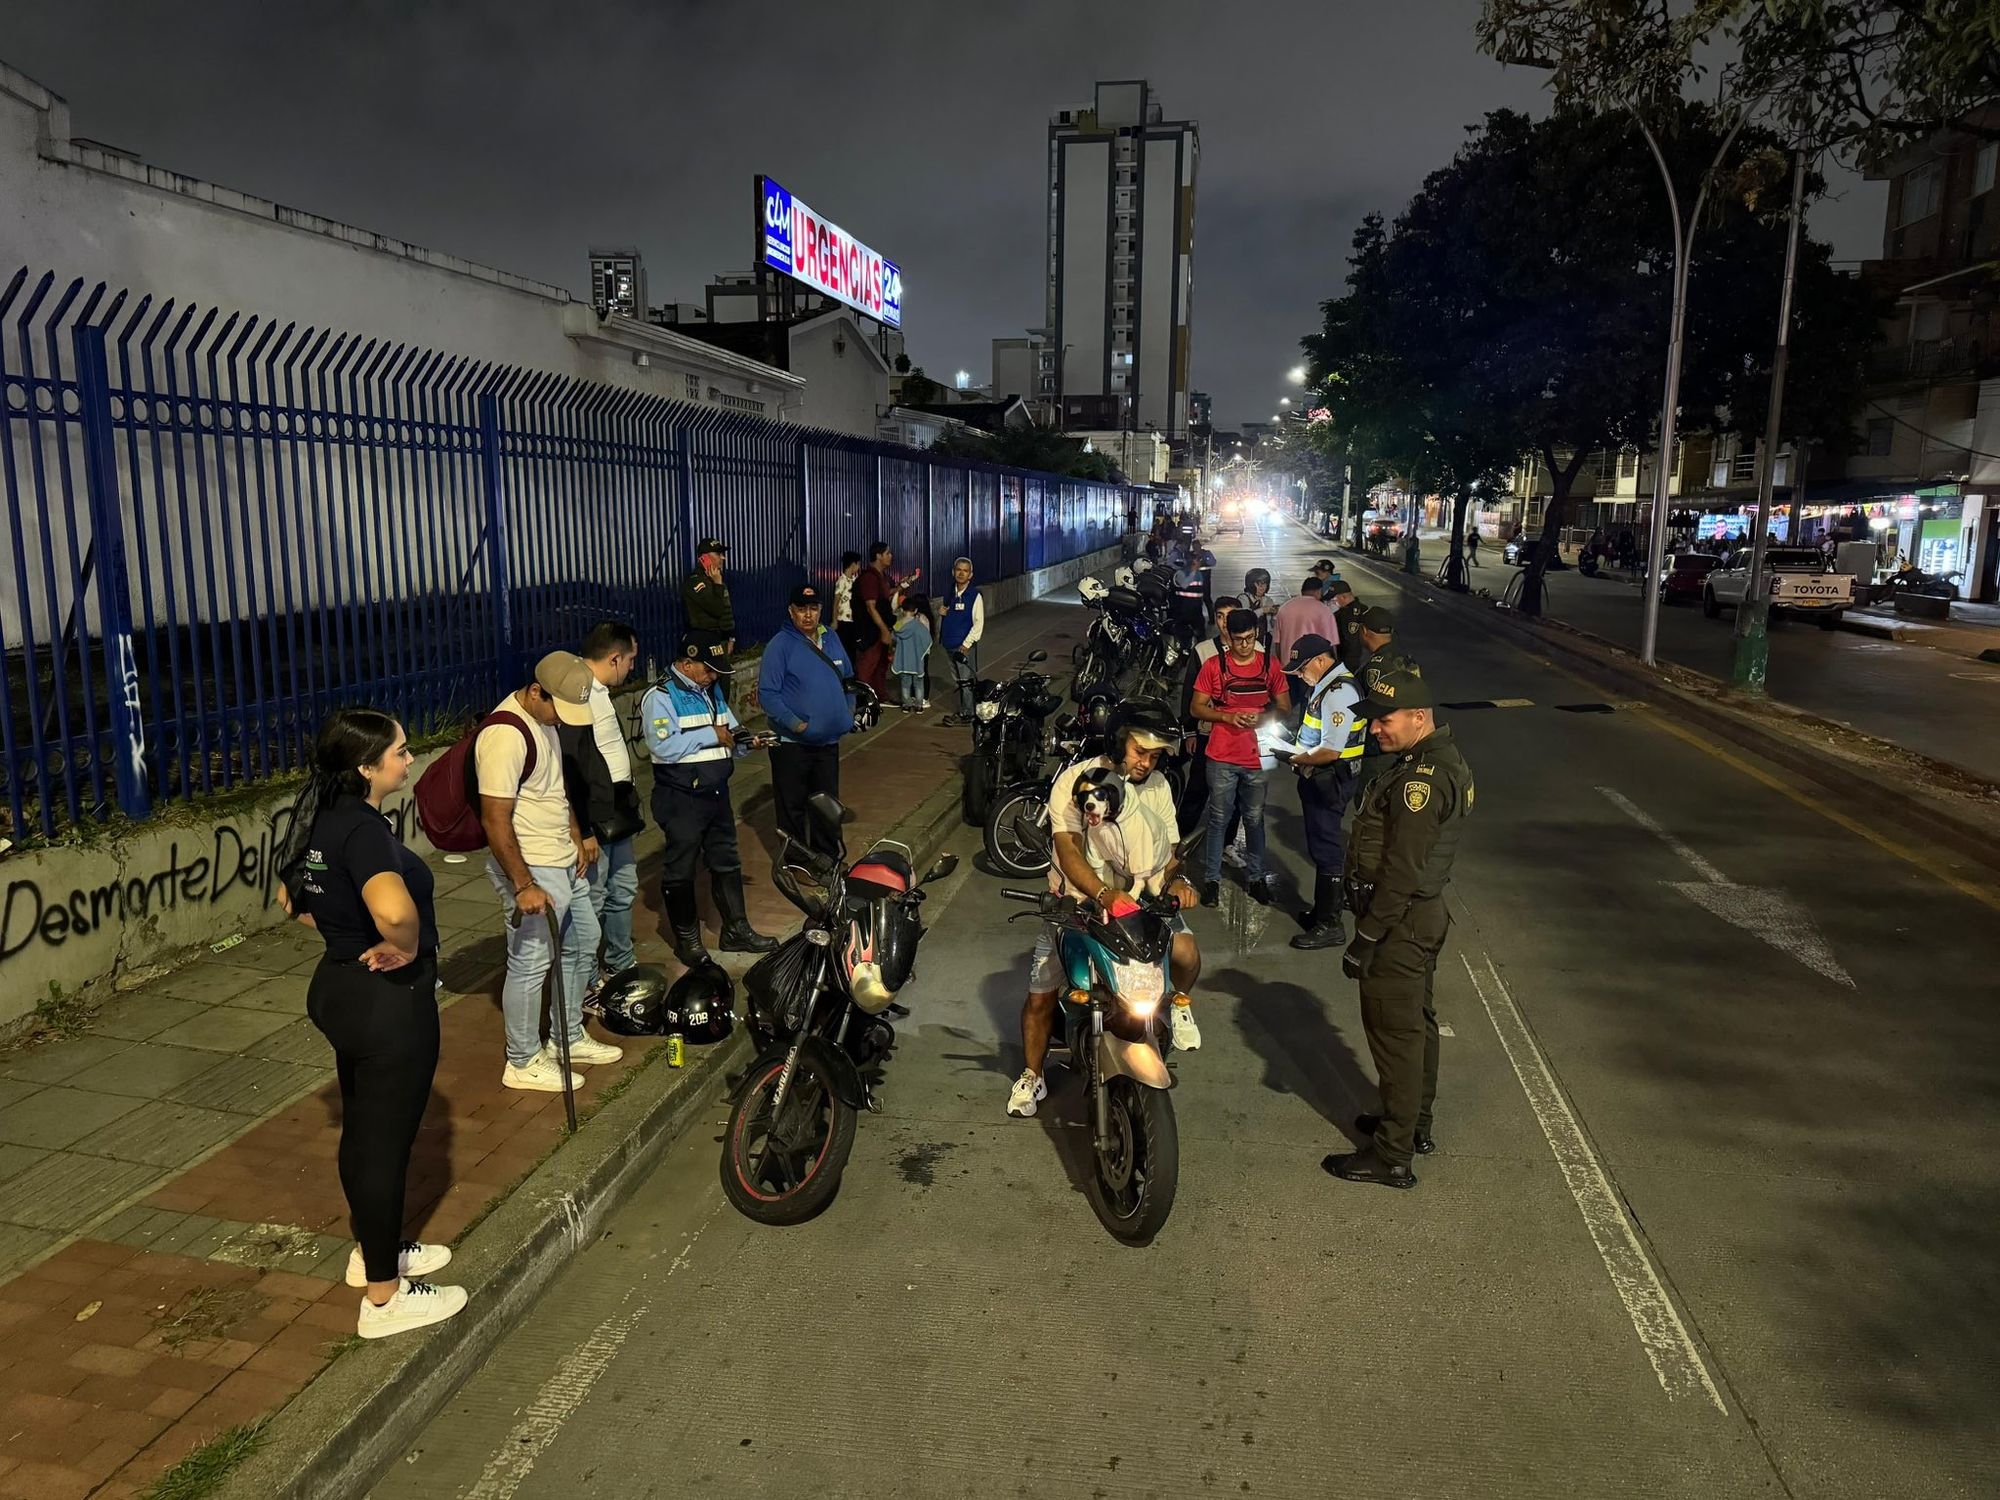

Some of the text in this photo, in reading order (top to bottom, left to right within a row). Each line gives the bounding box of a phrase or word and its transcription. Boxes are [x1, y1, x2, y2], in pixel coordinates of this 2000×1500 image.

[793, 207, 881, 313] URGENCIAS
[884, 267, 901, 305] 24
[1793, 586, 1839, 594] TOYOTA
